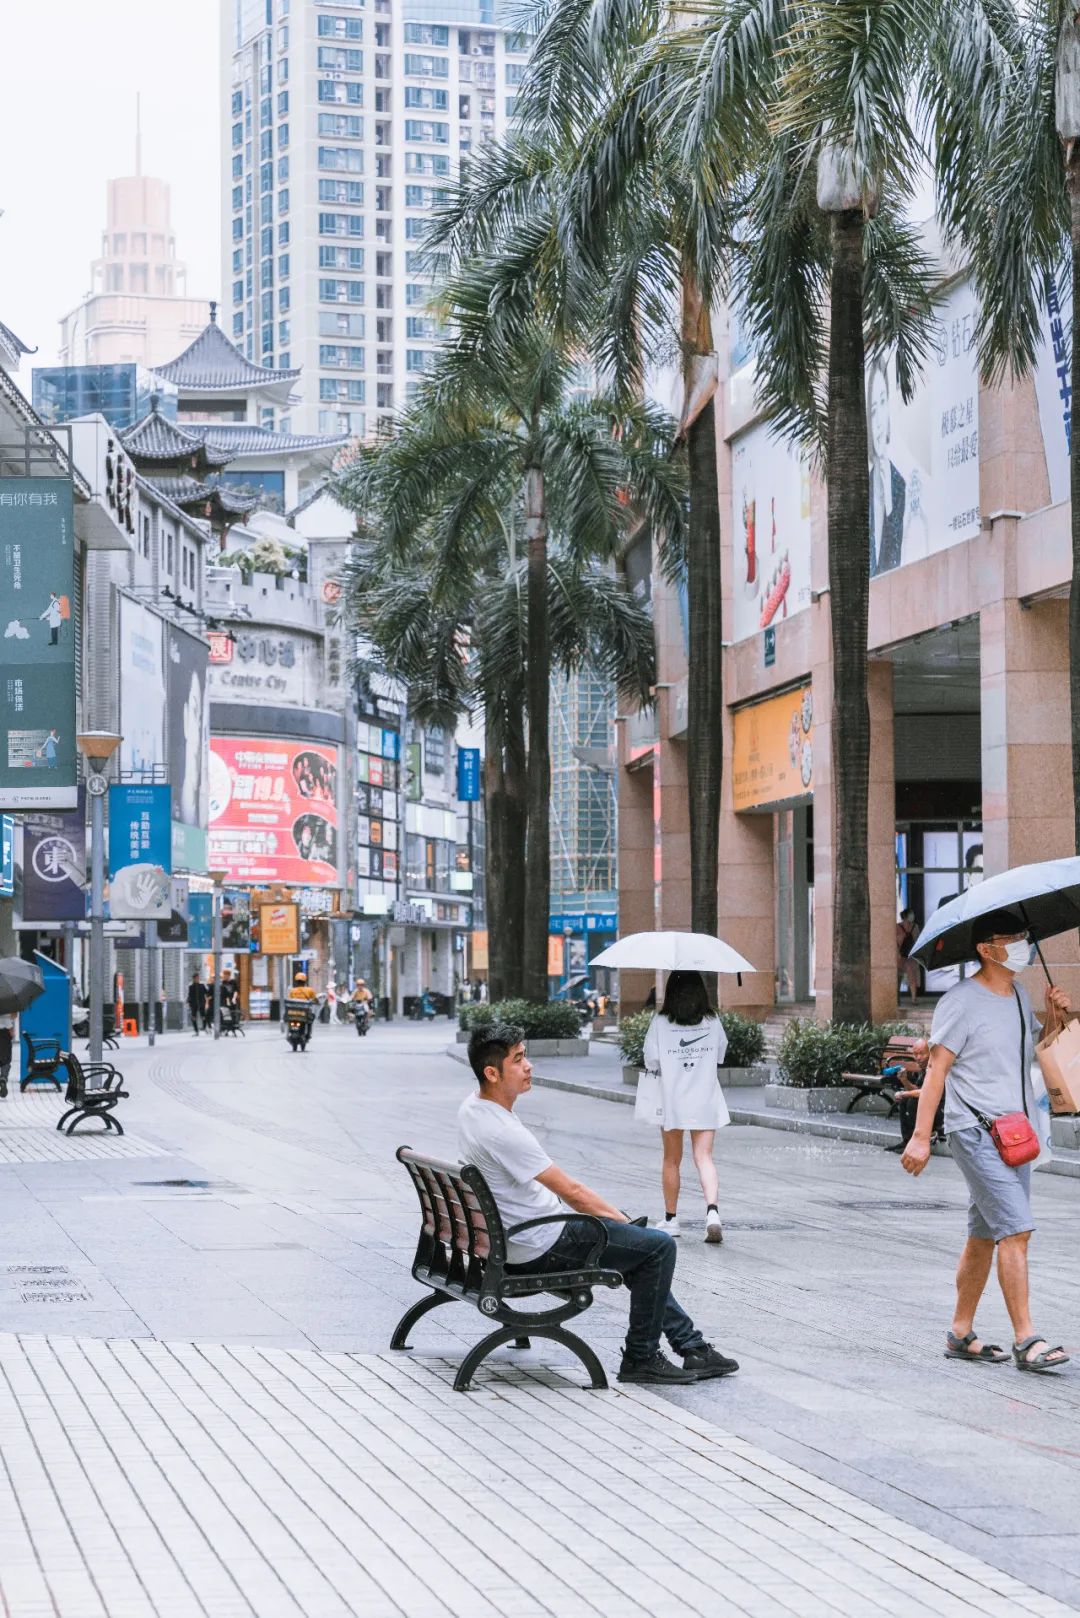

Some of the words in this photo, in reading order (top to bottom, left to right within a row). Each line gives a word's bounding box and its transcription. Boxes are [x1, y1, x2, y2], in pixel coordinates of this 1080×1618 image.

[0, 492, 58, 506] 有你有我
[668, 1047, 713, 1055] PHILOSOPHY
